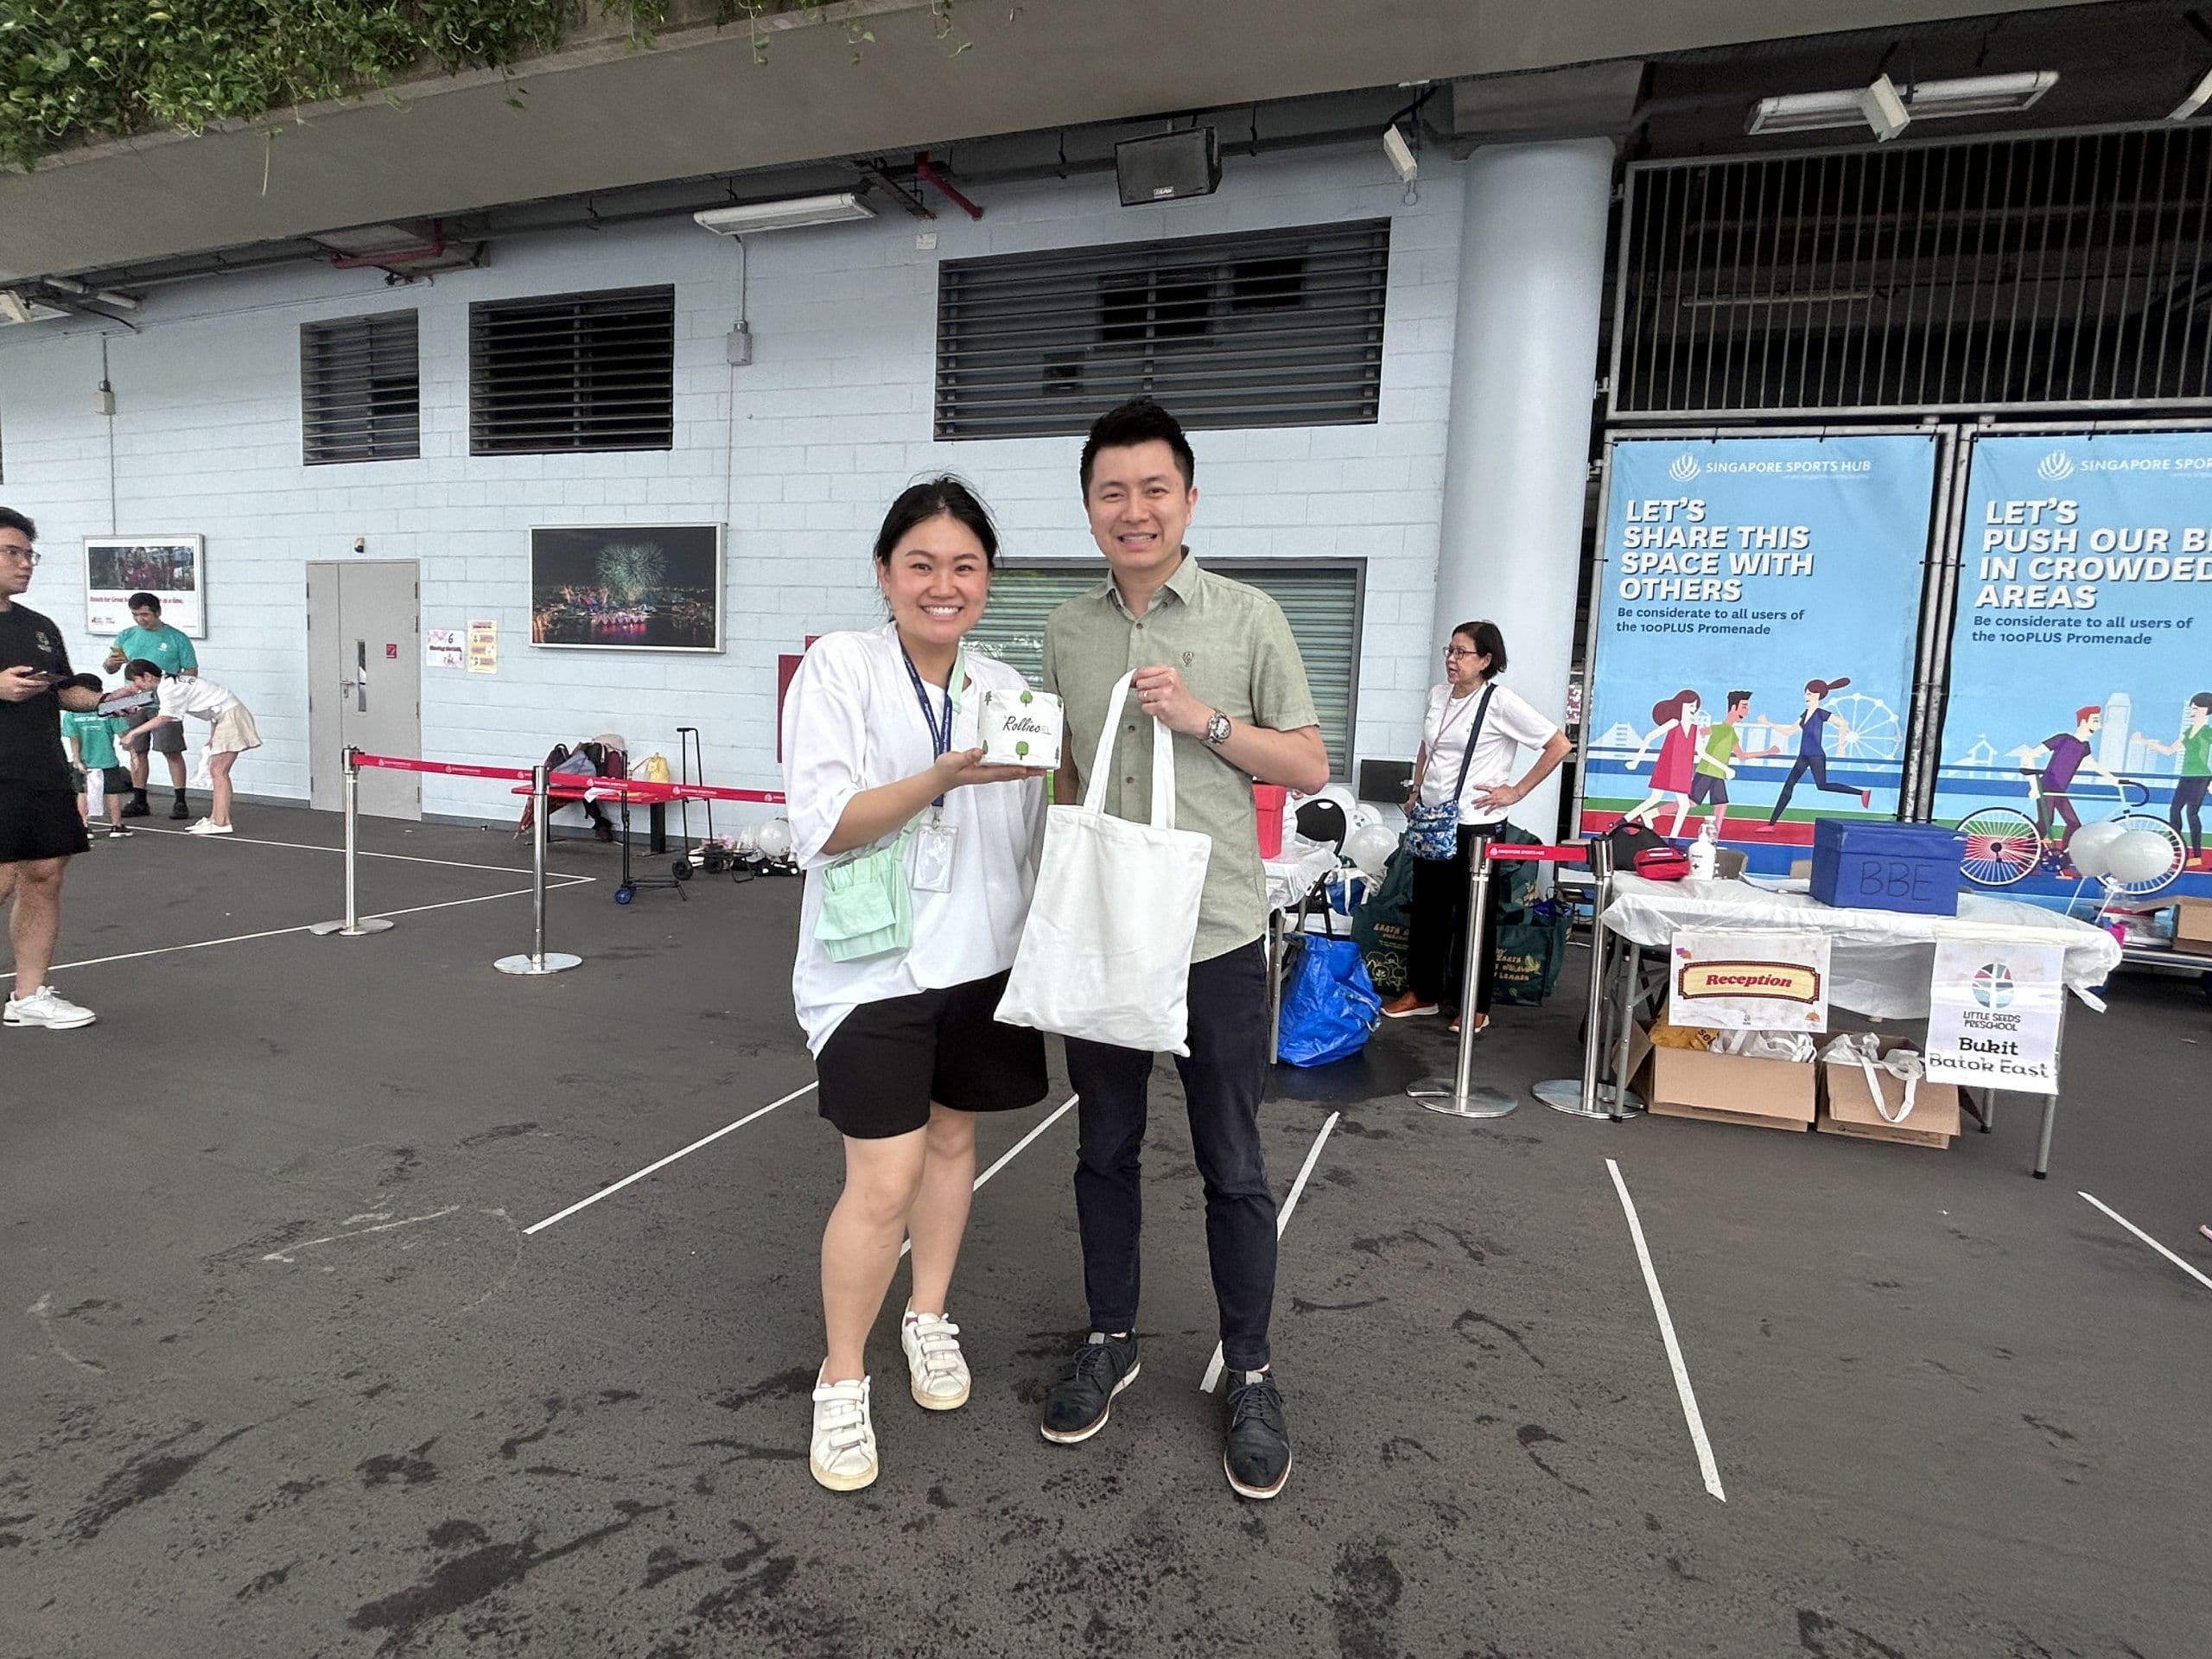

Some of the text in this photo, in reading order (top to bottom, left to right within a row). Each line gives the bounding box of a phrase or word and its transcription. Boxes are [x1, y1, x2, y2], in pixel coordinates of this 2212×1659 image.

[1706, 461, 1872, 474] SINGAPORE SPORTS HUB
[2080, 460, 2171, 471] SINGAPORE
[1625, 496, 1706, 523] LET'S
[1986, 498, 2079, 525] LET'S
[1623, 525, 1810, 550] SHARE THIS
[1982, 528, 2078, 553] PUSH
[2090, 528, 2171, 553] OUR
[1621, 551, 1814, 576] SPACE WITH
[1980, 556, 2018, 581] IN
[1618, 577, 1742, 602] OTHERS
[1974, 584, 2098, 609] AREAS
[1618, 607, 1805, 620] Be considerate to all users of
[1974, 615, 2194, 629] Be considerate to all users of
[1616, 621, 1771, 635] the 100PLUS Promenade
[1972, 631, 2152, 645] the 100PLUS Promenade
[1860, 861, 1934, 901] BBE
[1706, 974, 1792, 988] Reception
[1963, 1011, 2021, 1023] LITTLE SEEDS
[1964, 1020, 2018, 1031] PRESCHOOL
[1959, 1037, 2018, 1056] Bukit
[1929, 1053, 2050, 1078] Batok East
